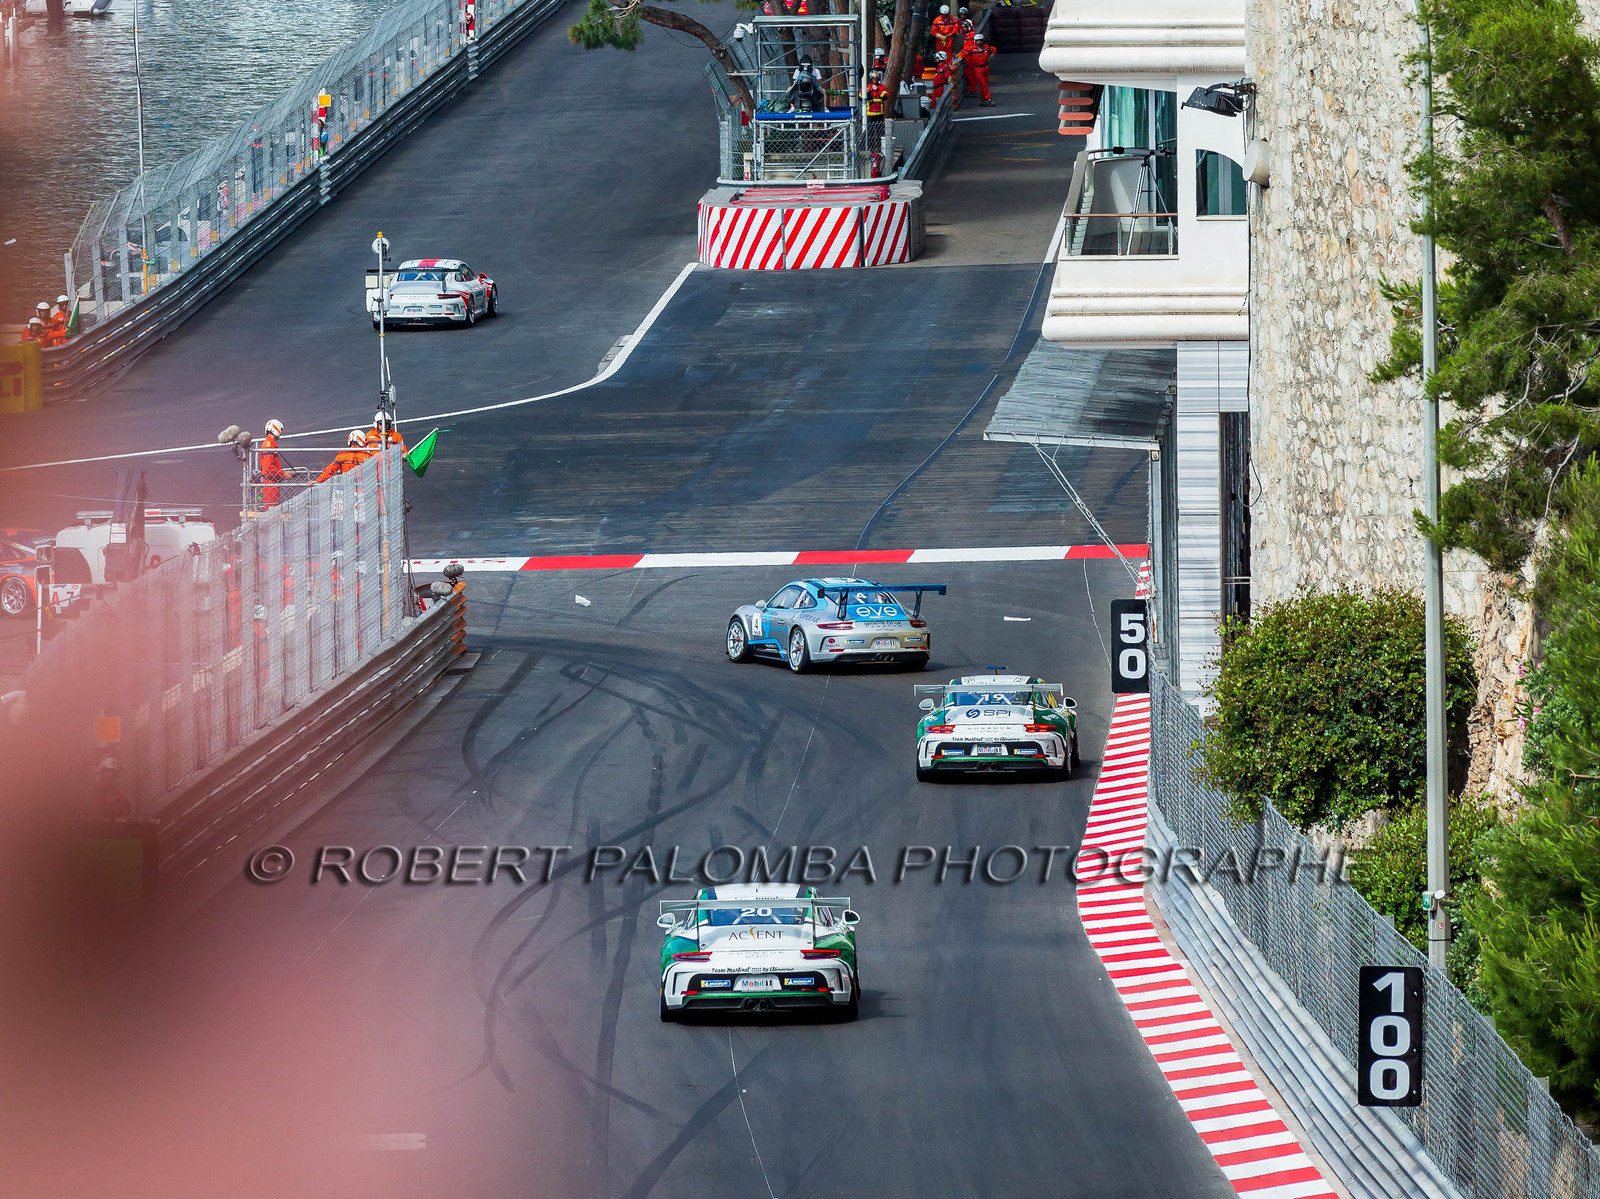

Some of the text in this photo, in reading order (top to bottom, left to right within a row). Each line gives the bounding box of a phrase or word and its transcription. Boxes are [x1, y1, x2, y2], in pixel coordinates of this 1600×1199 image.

[856, 606, 898, 617] eve
[1119, 613, 1147, 679] 50
[980, 693, 1005, 702] 19
[983, 709, 1011, 717] SPI
[740, 907, 773, 917] 20
[1370, 972, 1411, 1101] 100
